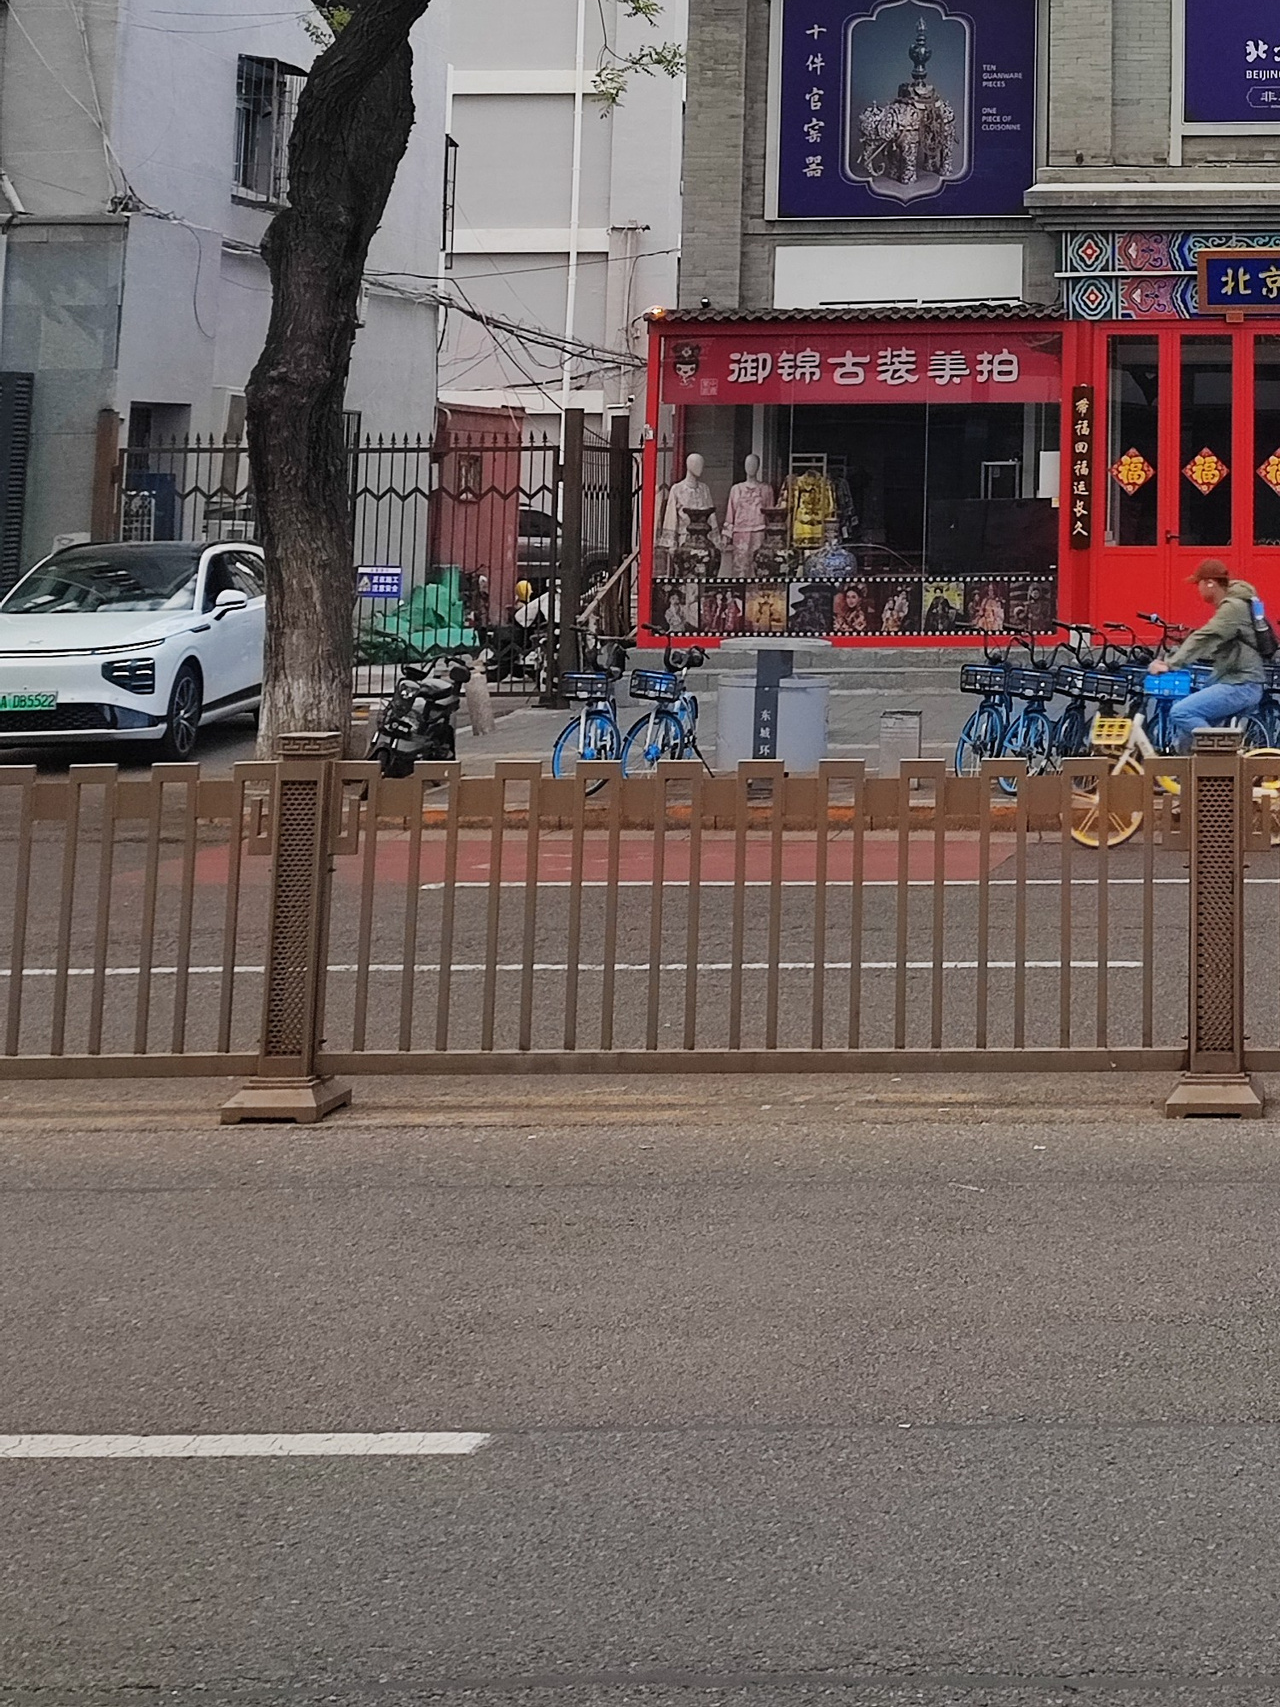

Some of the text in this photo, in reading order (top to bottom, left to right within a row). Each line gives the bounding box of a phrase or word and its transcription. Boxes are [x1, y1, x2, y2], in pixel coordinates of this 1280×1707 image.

[727, 346, 1019, 385] 御锦古装美拍
[1118, 455, 1147, 484] 福
[1192, 455, 1221, 484] 福
